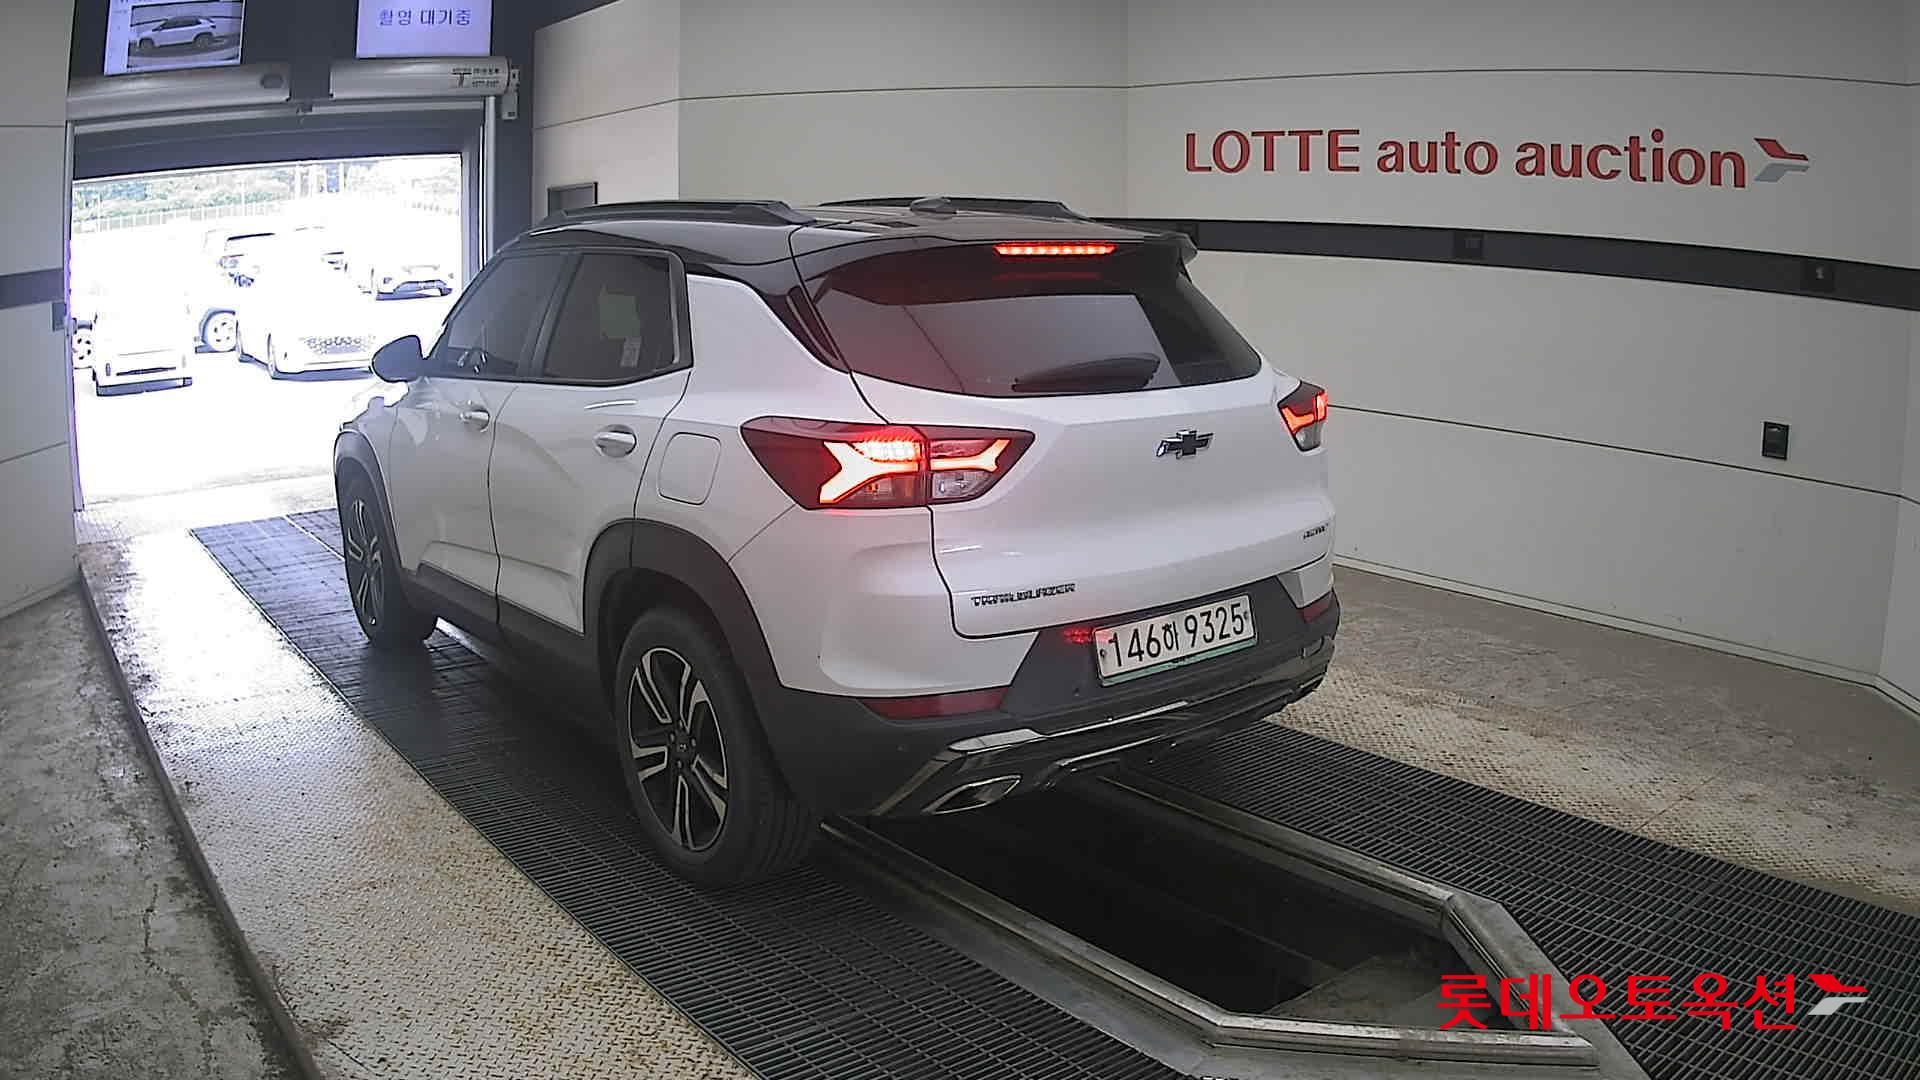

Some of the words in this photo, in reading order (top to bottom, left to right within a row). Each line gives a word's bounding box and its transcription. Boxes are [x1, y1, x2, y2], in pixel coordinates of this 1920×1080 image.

[421, 9, 471, 26] 대기중
[1185, 129, 1360, 173] LOTTE
[1376, 131, 1498, 175] auto
[1515, 128, 1747, 188] auction
[1184, 602, 1244, 648] 9325
